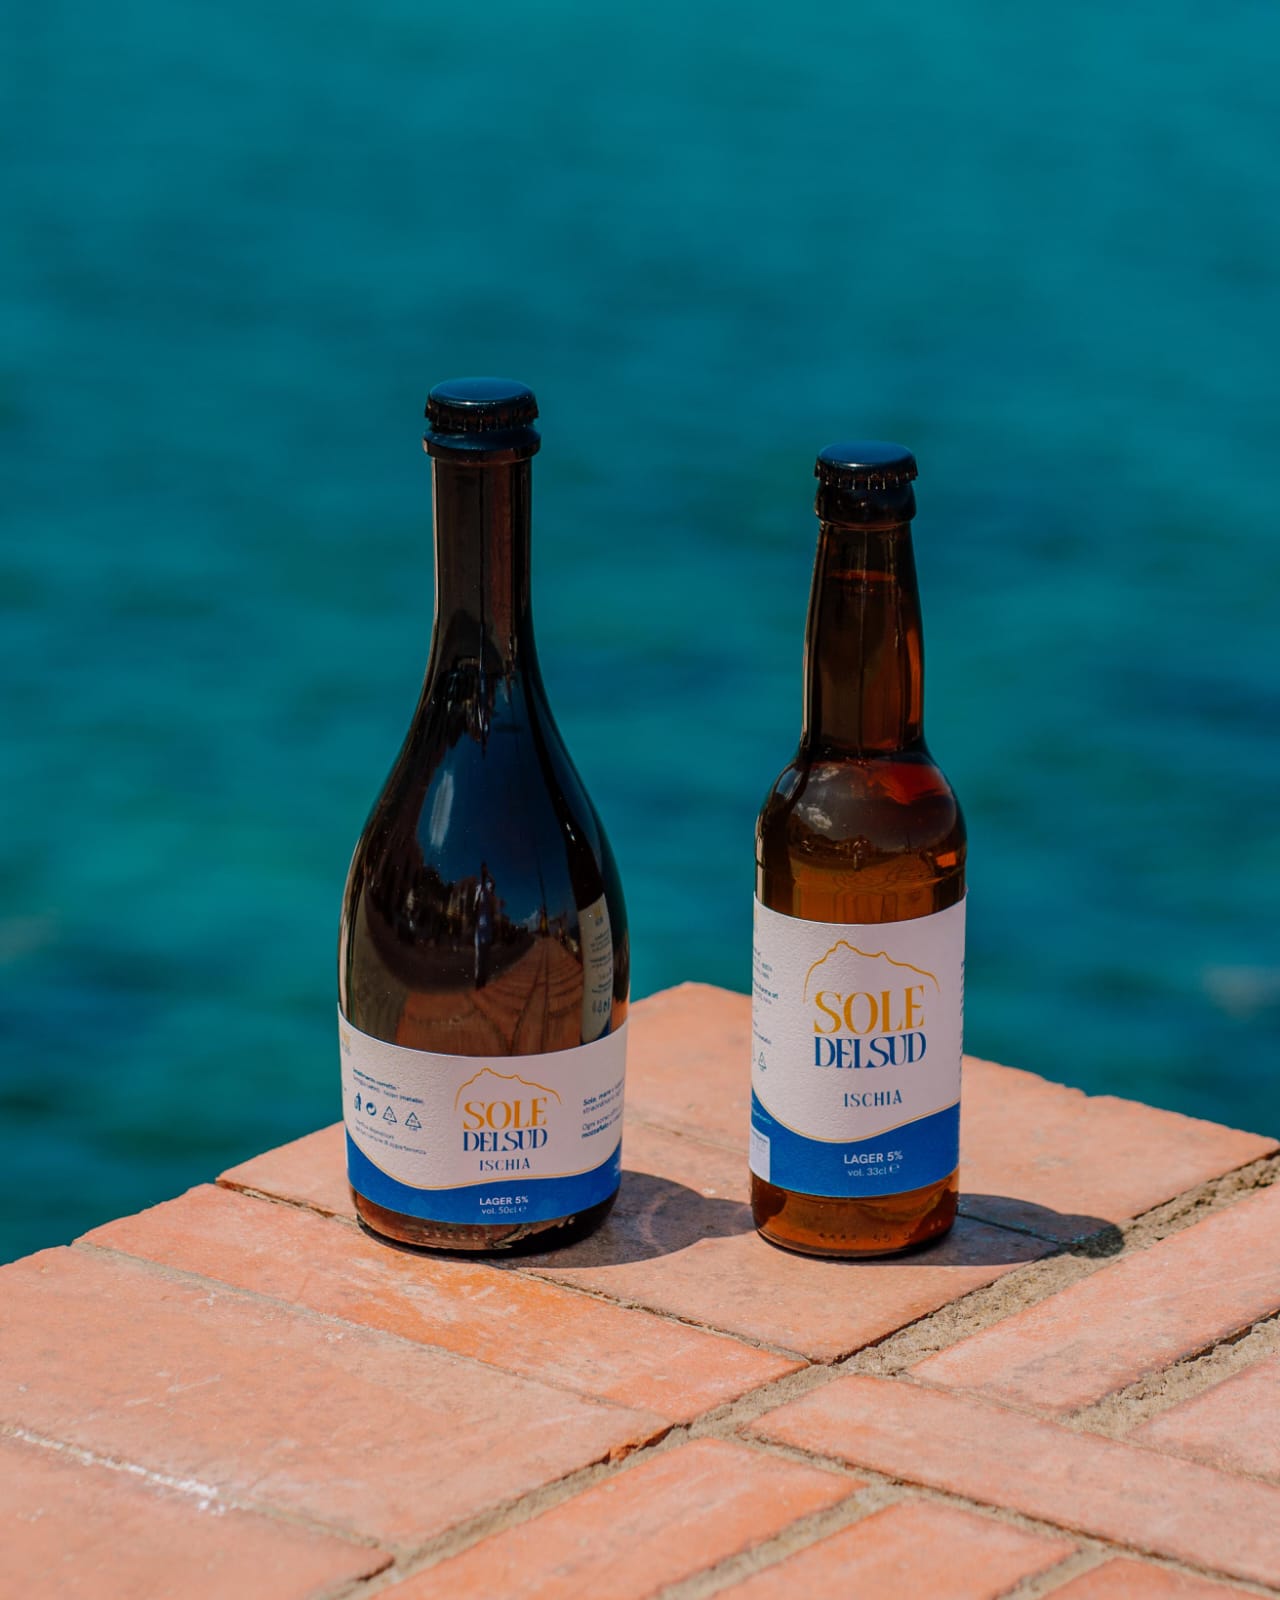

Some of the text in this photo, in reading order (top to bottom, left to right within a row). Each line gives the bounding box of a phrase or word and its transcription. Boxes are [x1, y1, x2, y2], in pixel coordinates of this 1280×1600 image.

[813, 983, 925, 1035] SOLE
[843, 1089, 903, 1108] ISCHIA
[463, 1096, 547, 1129] SOLE
[844, 1150, 903, 1164] LAGER 5%
[479, 1158, 531, 1172] ISCHIA
[847, 1167, 887, 1177] vol. 33cl
[479, 1195, 529, 1206] LAGER 5%
[498, 1206, 517, 1214] 50cl
